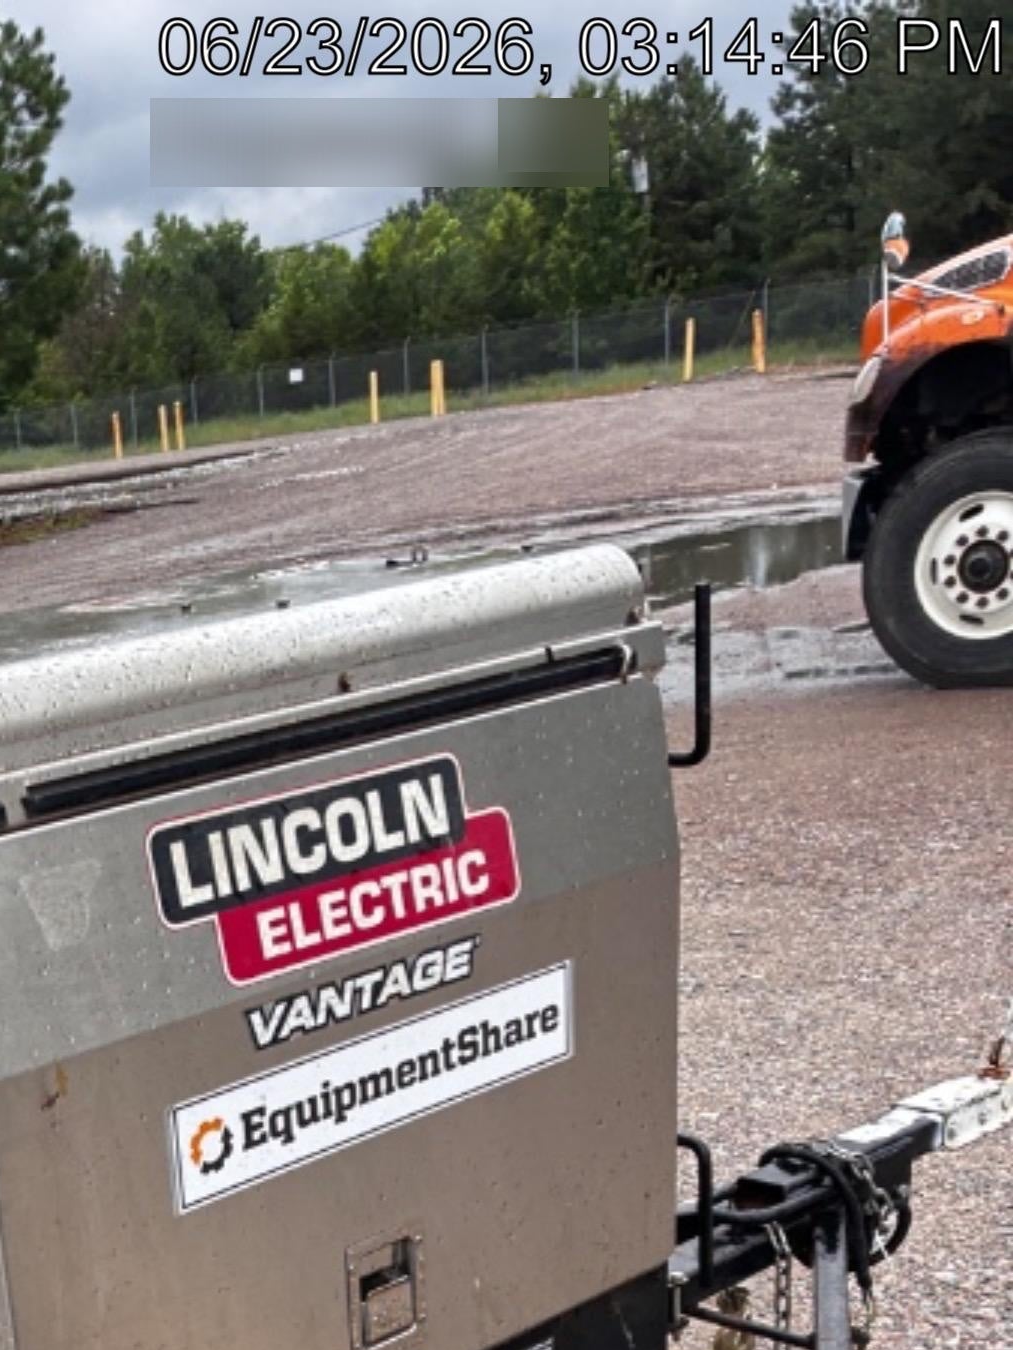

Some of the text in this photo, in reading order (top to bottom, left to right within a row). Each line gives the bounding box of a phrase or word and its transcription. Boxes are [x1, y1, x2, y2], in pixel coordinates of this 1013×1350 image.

[169, 772, 452, 910] LINCOLN
[255, 848, 491, 960] ELECTRIC
[245, 936, 477, 1050] VANTAGE
[240, 1003, 560, 1151] EquipmentShare
